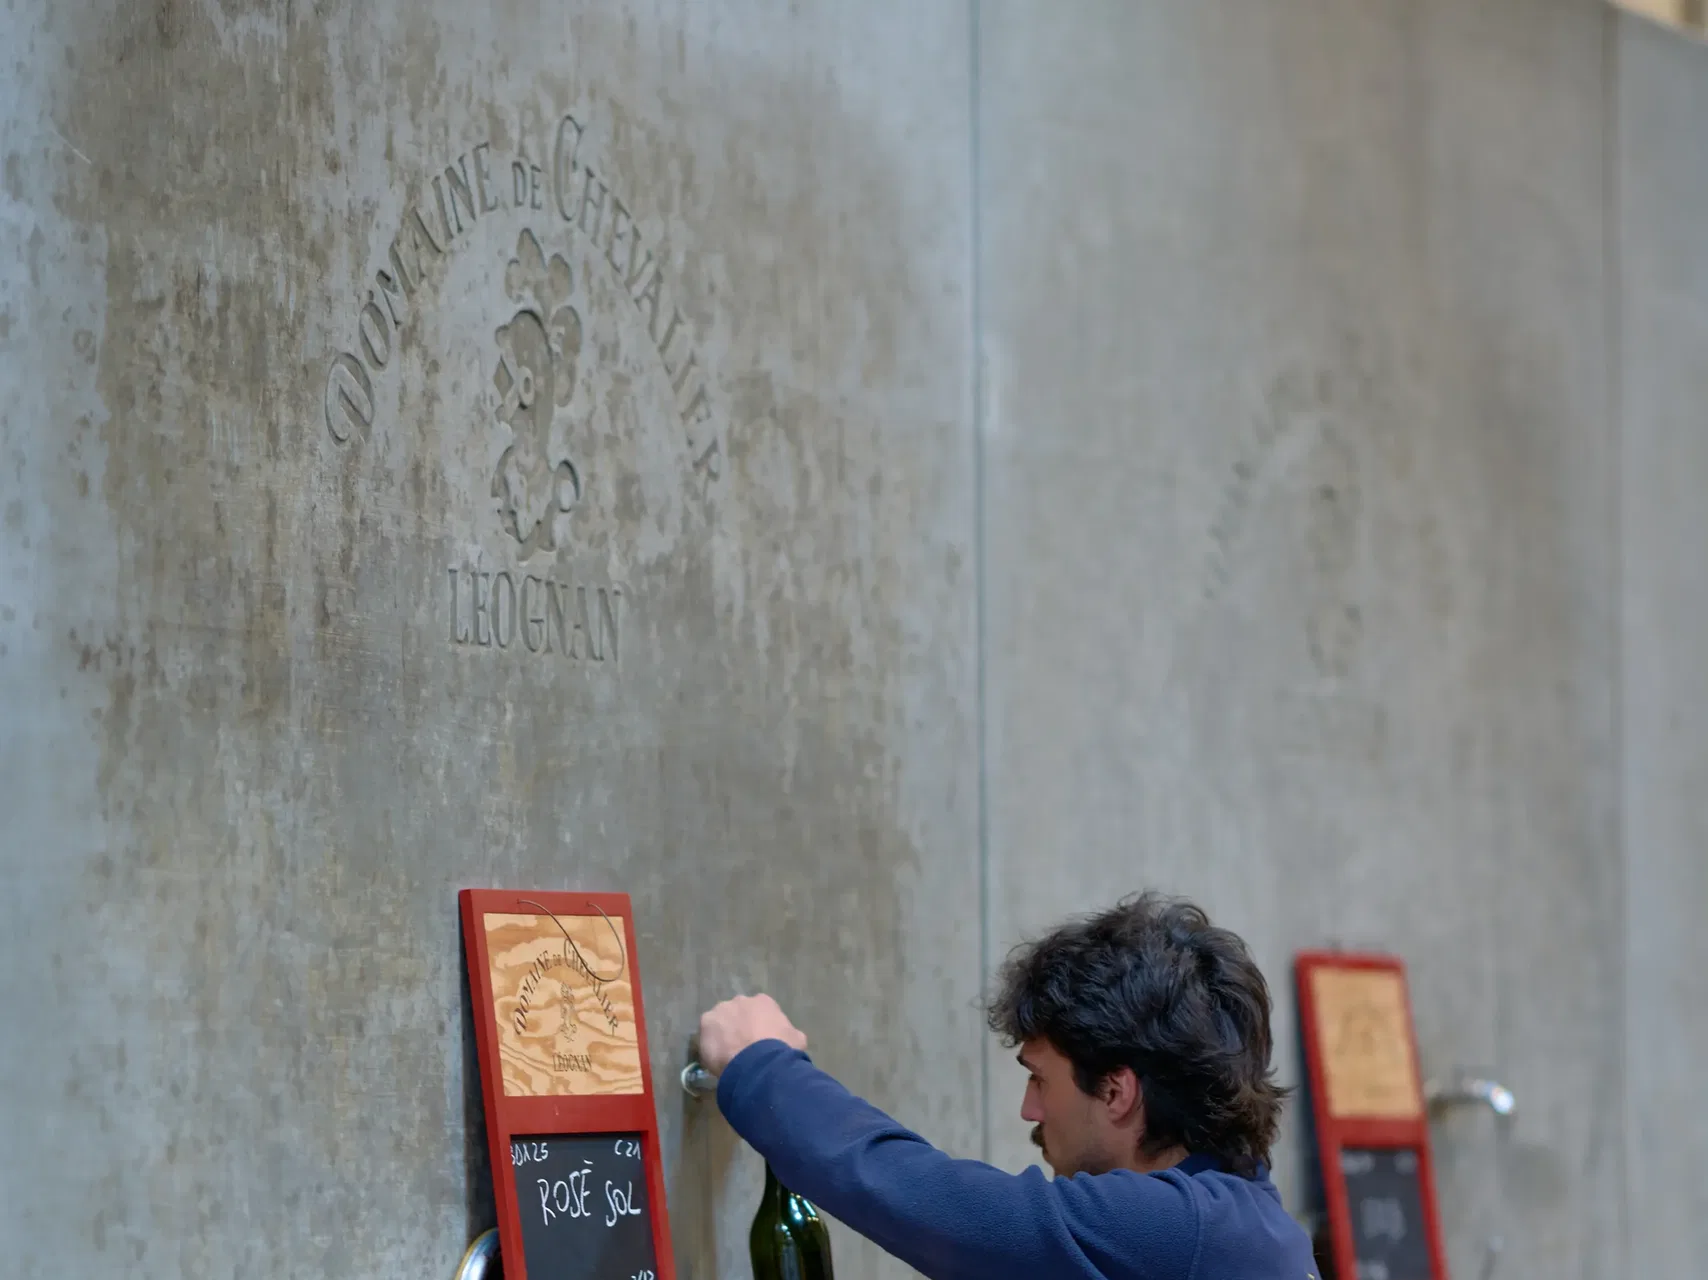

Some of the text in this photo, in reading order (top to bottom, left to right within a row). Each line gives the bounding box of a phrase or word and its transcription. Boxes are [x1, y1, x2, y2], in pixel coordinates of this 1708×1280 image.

[324, 114, 723, 494] DOMAINE DE CHEVALIER
[513, 950, 553, 1036] DOMAINE
[605, 1180, 642, 1228] SOL
